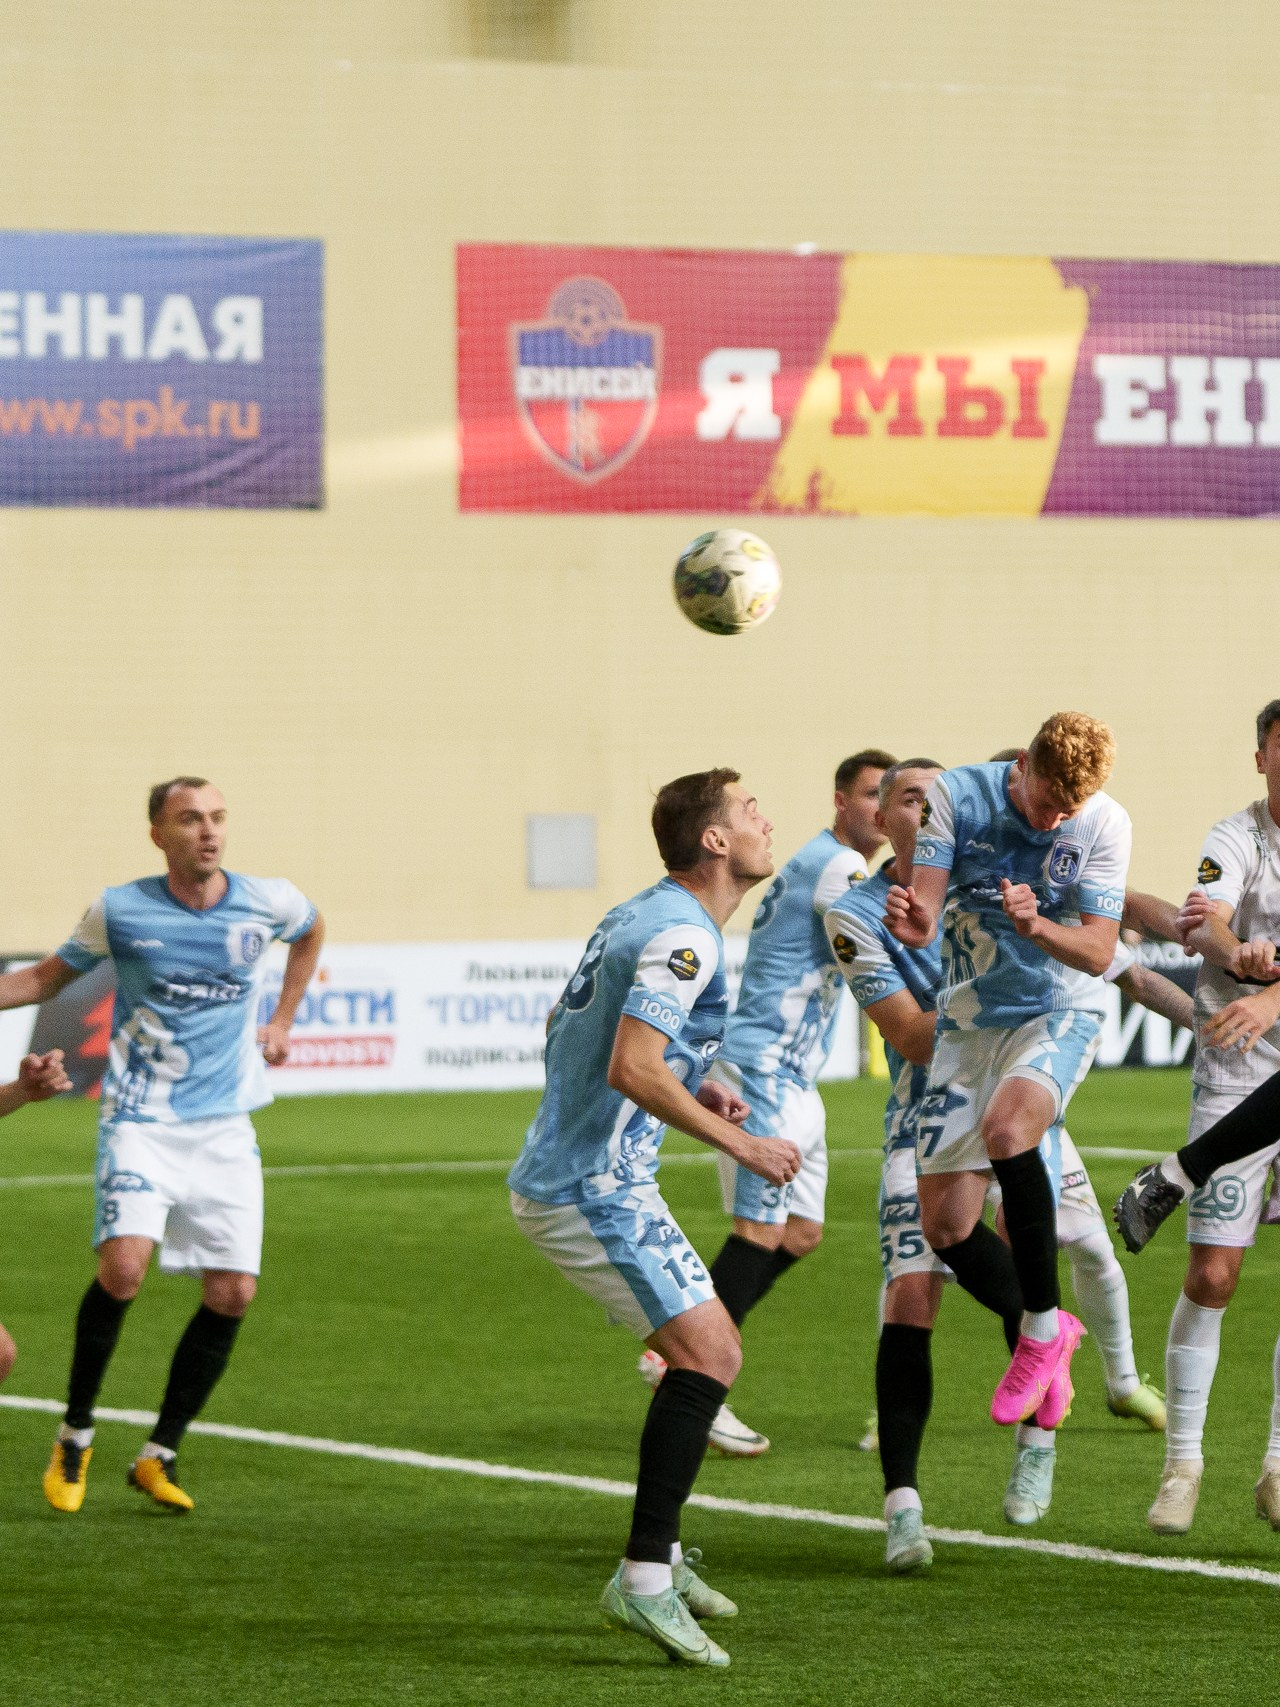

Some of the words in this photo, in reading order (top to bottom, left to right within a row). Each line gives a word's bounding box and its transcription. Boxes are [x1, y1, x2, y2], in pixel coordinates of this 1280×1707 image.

[517, 364, 658, 400] ЕНИСЕЙ
[696, 348, 782, 442] Я
[829, 354, 1049, 440] МЫ
[639, 998, 681, 1031] 1000
[919, 1125, 946, 1158] 7
[102, 1200, 119, 1226] 8
[760, 1182, 794, 1209] 38
[1188, 1175, 1248, 1221] 29
[881, 1229, 925, 1268] 55
[661, 1250, 707, 1290] 13
